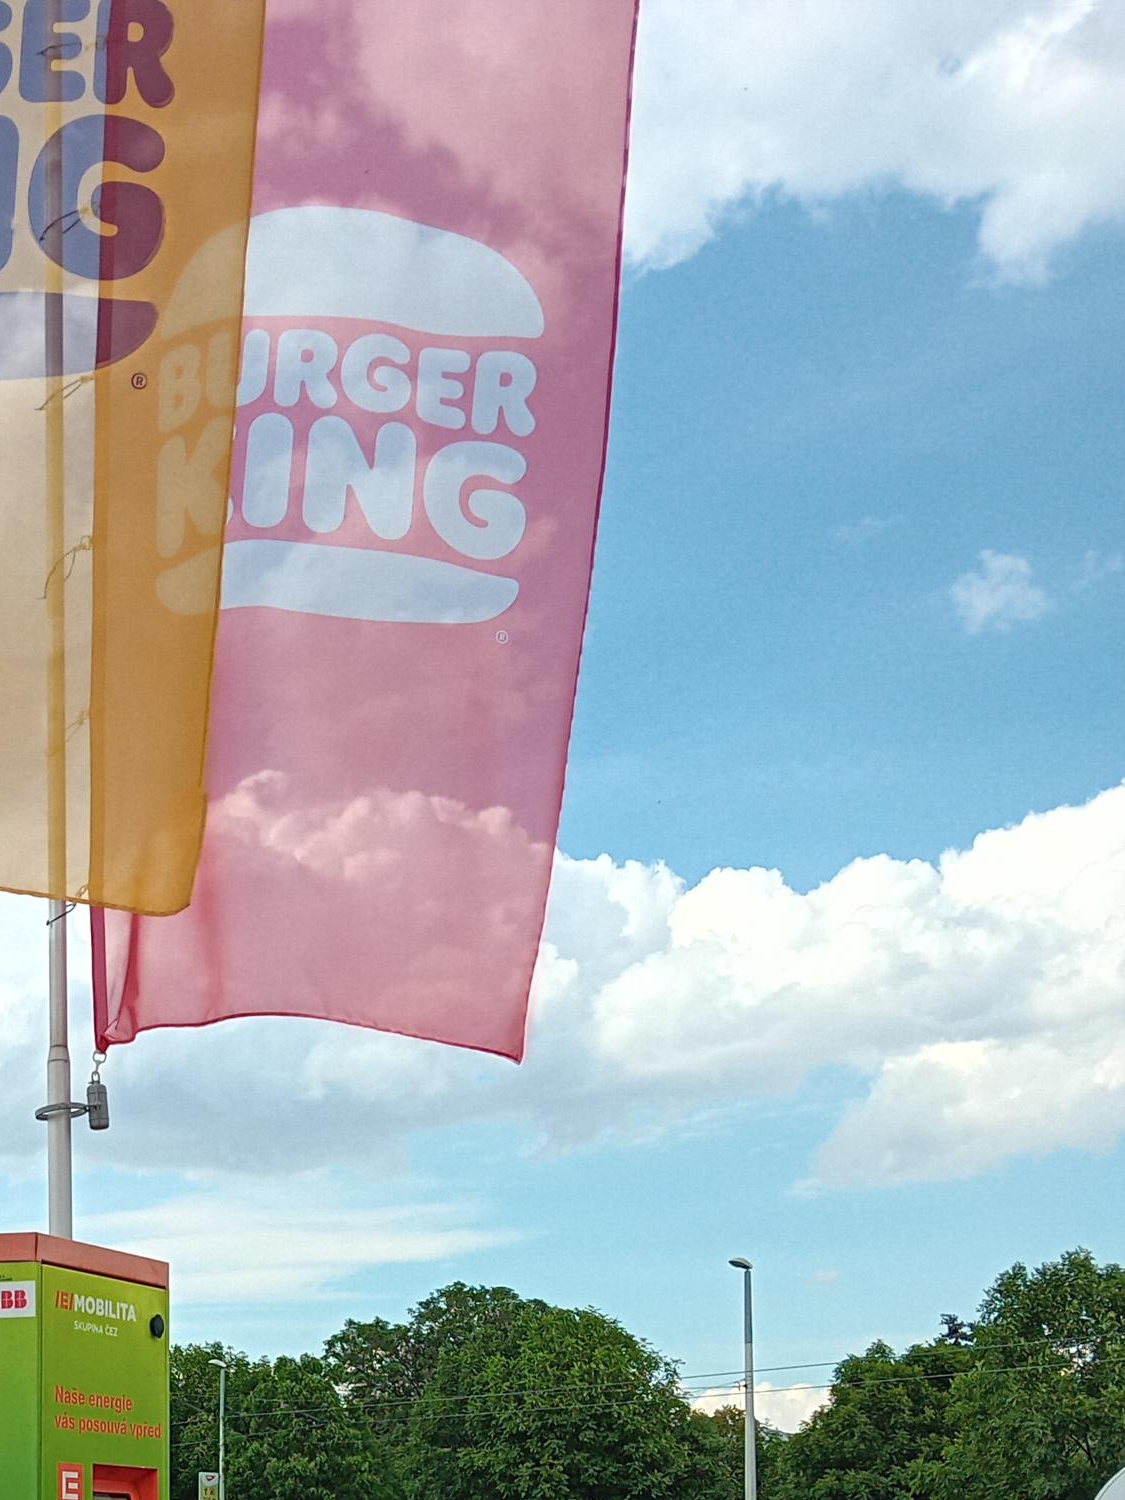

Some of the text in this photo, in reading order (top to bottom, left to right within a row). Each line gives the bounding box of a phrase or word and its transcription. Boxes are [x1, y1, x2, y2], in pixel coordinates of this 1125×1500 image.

[74, 1320, 118, 1337] SKUPINA ČEZ
[55, 1385, 132, 1413] Naše energie
[54, 1412, 161, 1440] vás posouvá vpřed
